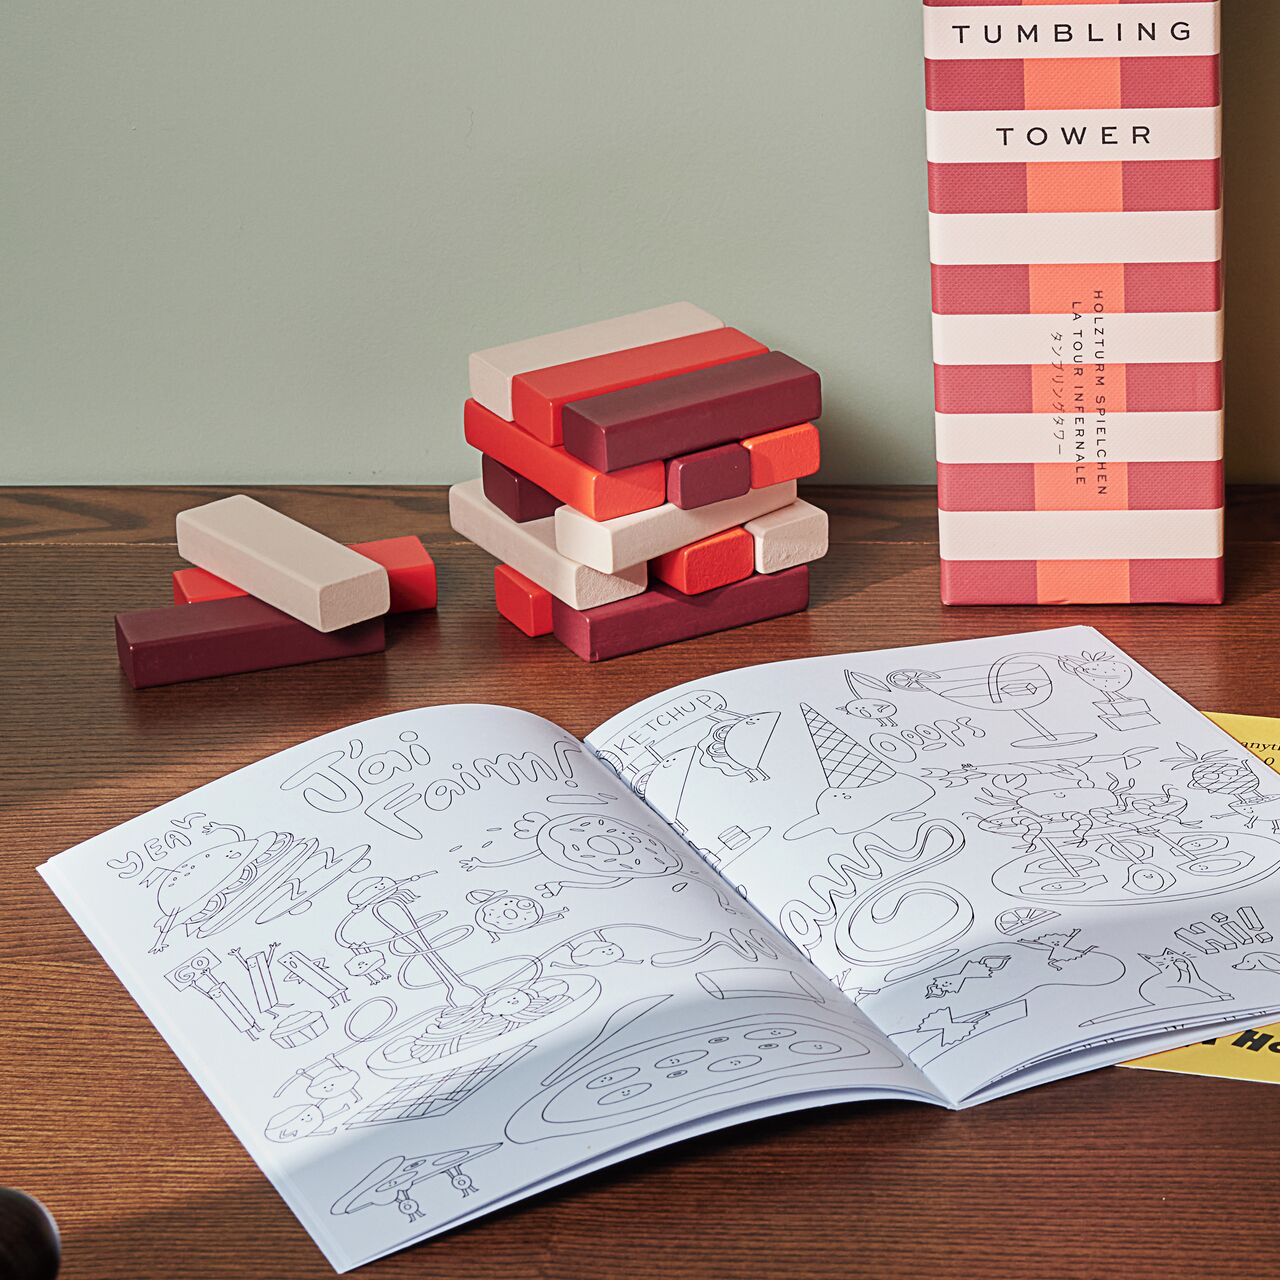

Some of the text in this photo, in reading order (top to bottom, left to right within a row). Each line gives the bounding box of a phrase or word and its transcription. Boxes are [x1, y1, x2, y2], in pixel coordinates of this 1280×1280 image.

[951, 21, 1191, 44] TUMBLING
[995, 125, 1151, 146] TOWER
[1071, 301, 1086, 485] LA TOUR INFERNALE
[1093, 290, 1108, 495] HOLZTURM SPIELCHEN
[614, 694, 713, 757] KETCHUP
